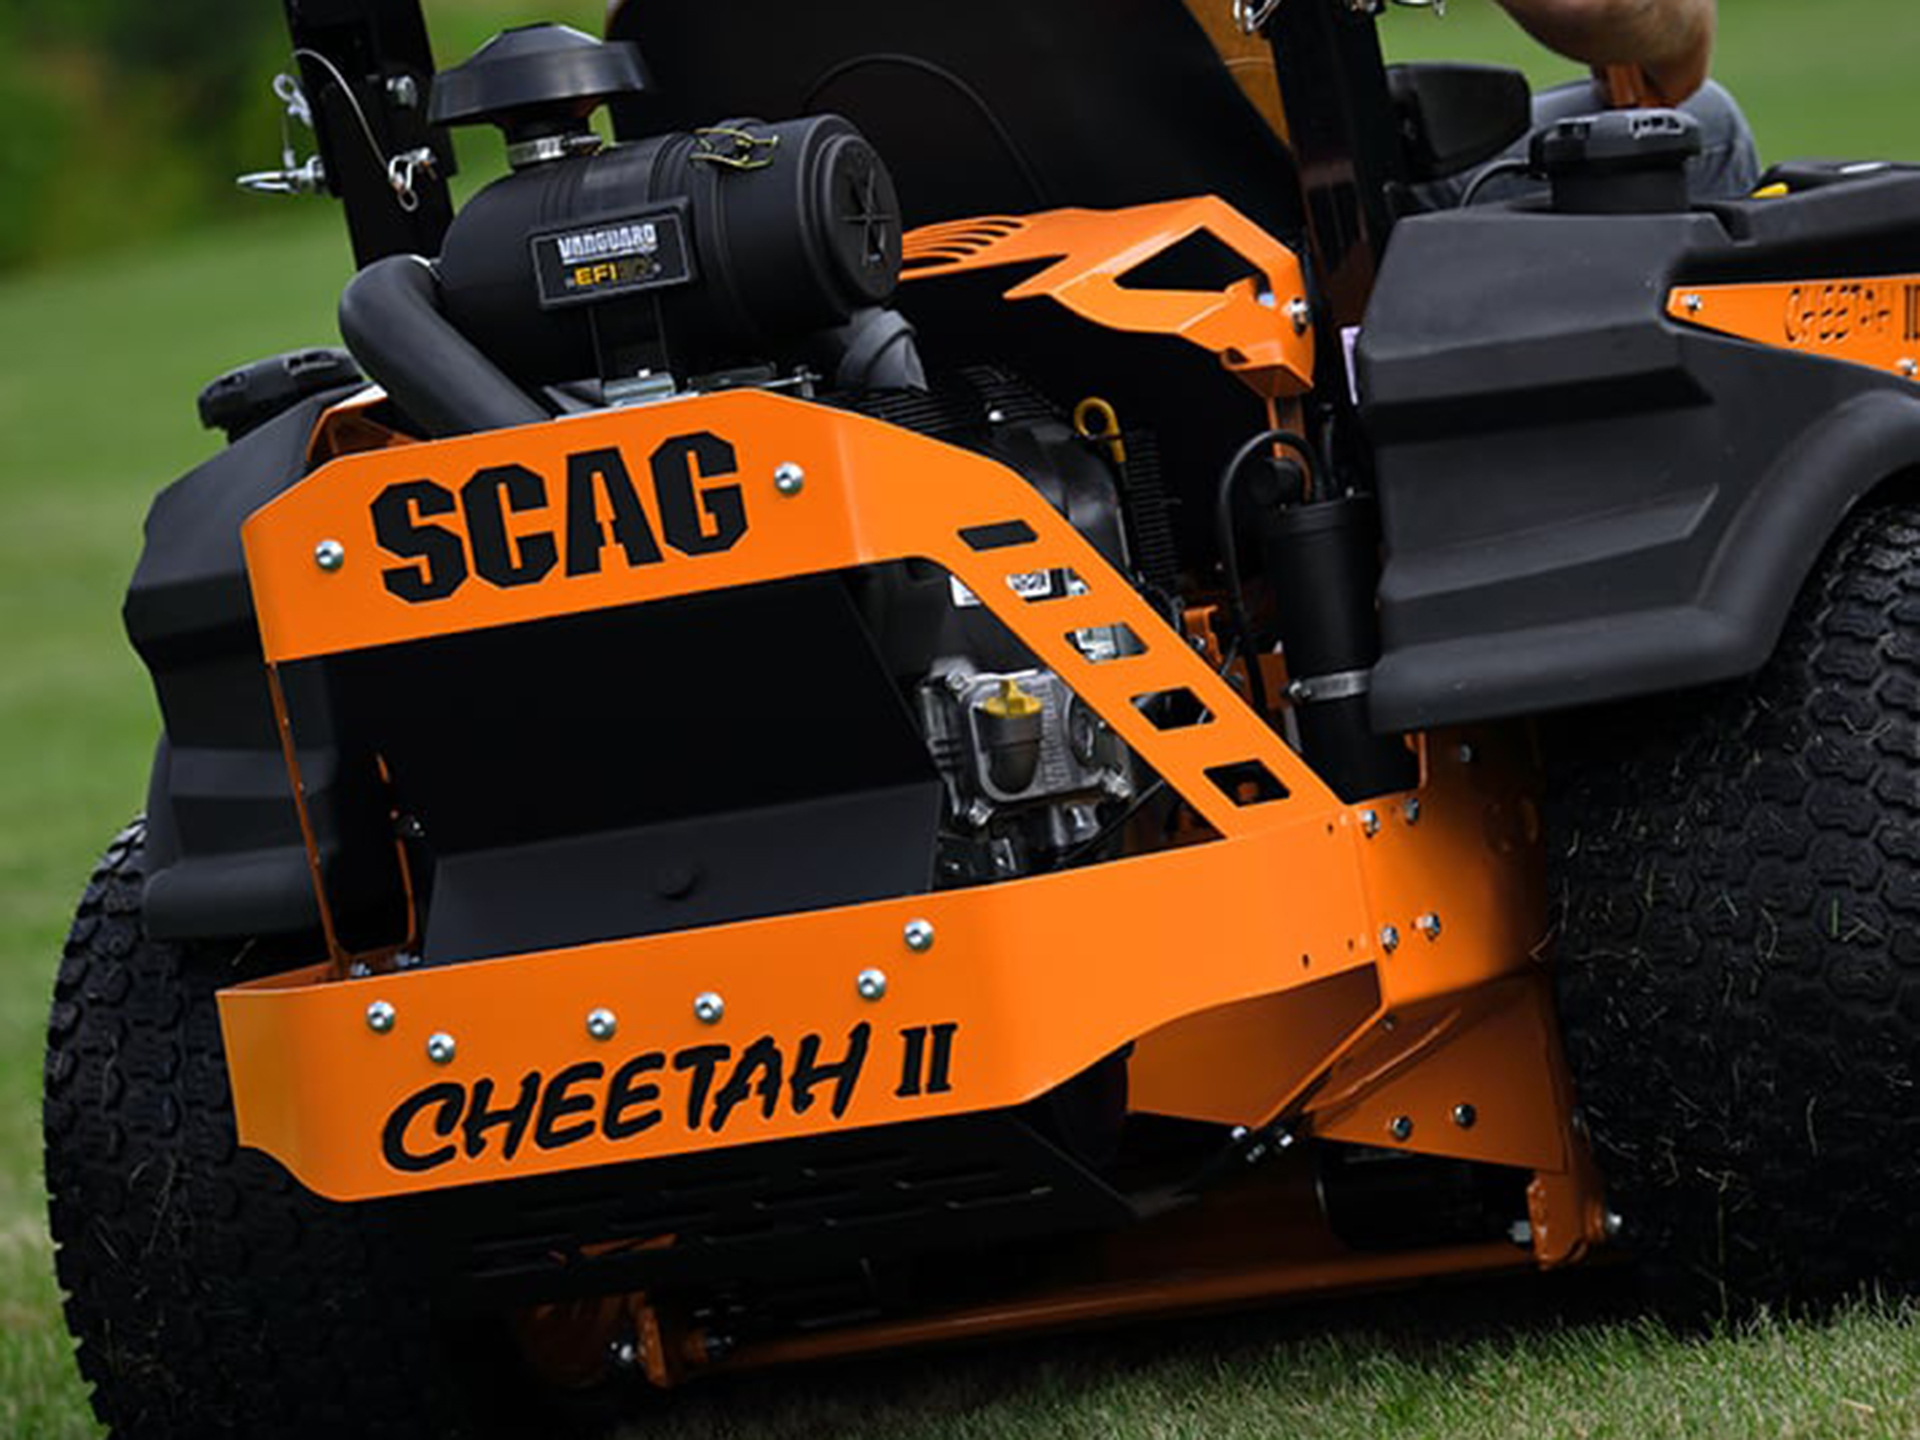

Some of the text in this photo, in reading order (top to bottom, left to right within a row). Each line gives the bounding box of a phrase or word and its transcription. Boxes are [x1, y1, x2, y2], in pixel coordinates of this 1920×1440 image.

[557, 224, 657, 258] VANGUARD
[574, 262, 618, 286] EFI
[370, 430, 748, 604] SCAG
[381, 1021, 957, 1172] CHEETAH II
